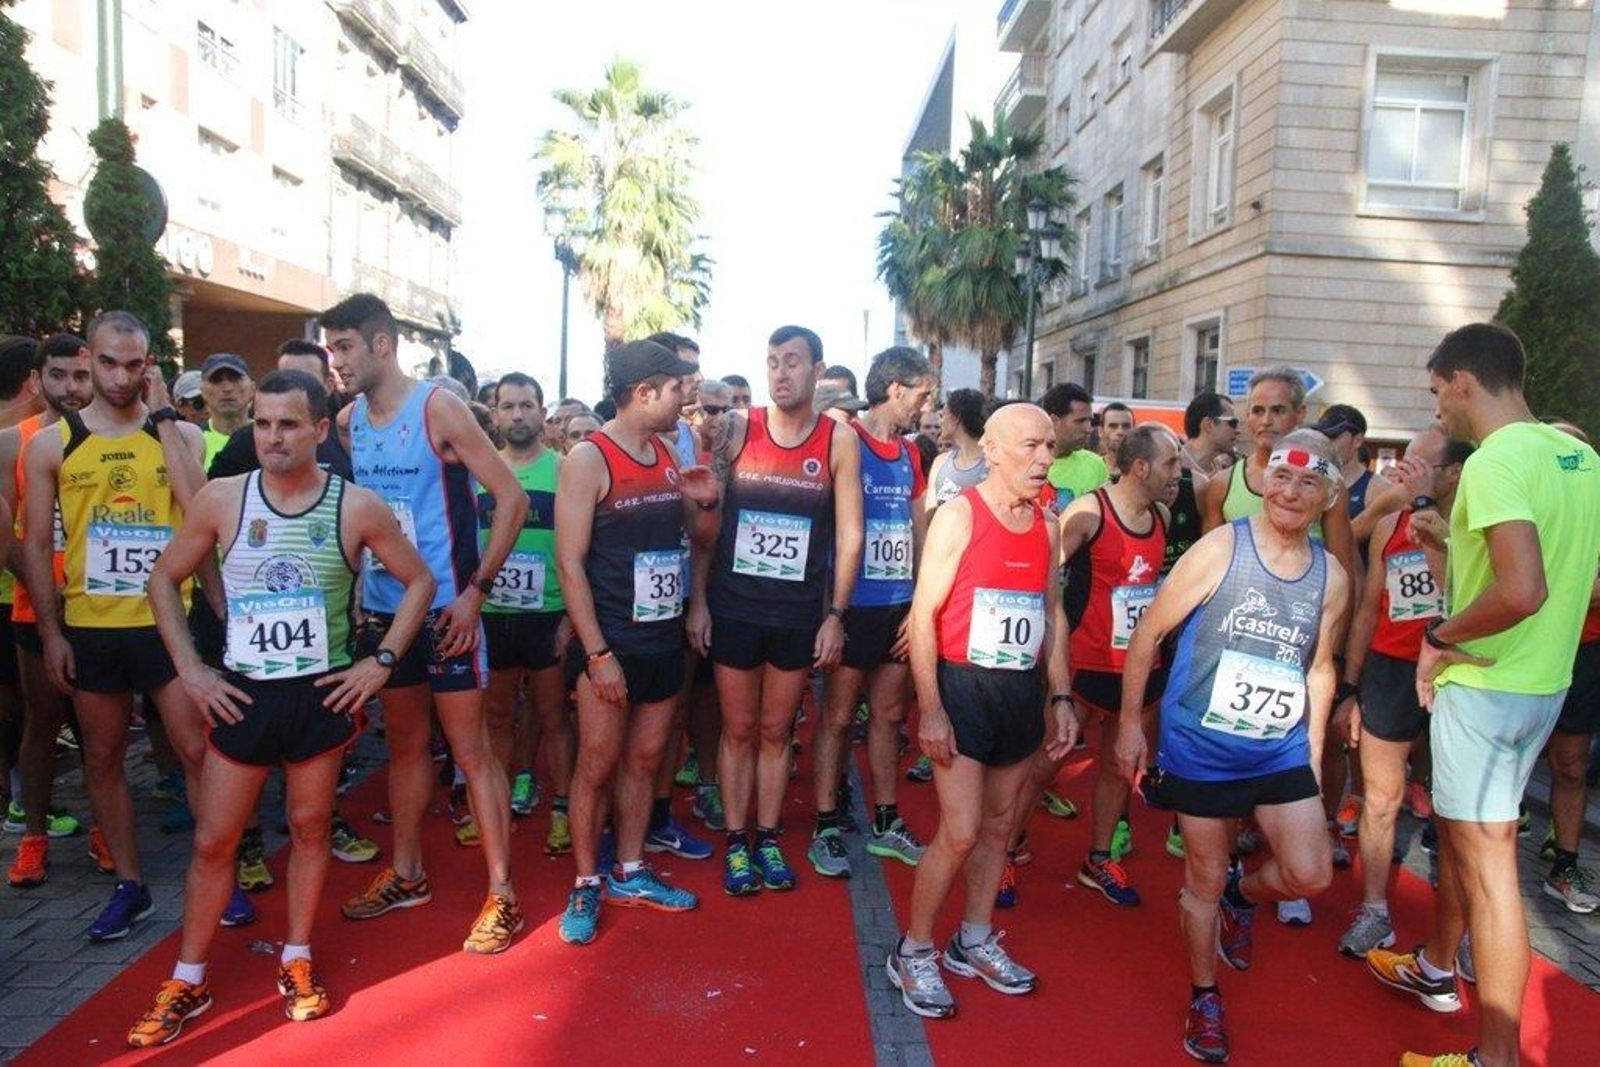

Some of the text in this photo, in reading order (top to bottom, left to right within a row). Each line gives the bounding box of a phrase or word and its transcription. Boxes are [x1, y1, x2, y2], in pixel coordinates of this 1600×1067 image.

[92, 502, 156, 525] Reale
[749, 532, 799, 560] 325
[871, 540, 909, 562] 1061
[105, 547, 162, 574] 153
[1400, 570, 1435, 598] 88
[249, 618, 316, 653] 404
[998, 616, 1031, 646] 10
[1229, 681, 1296, 719] 375
